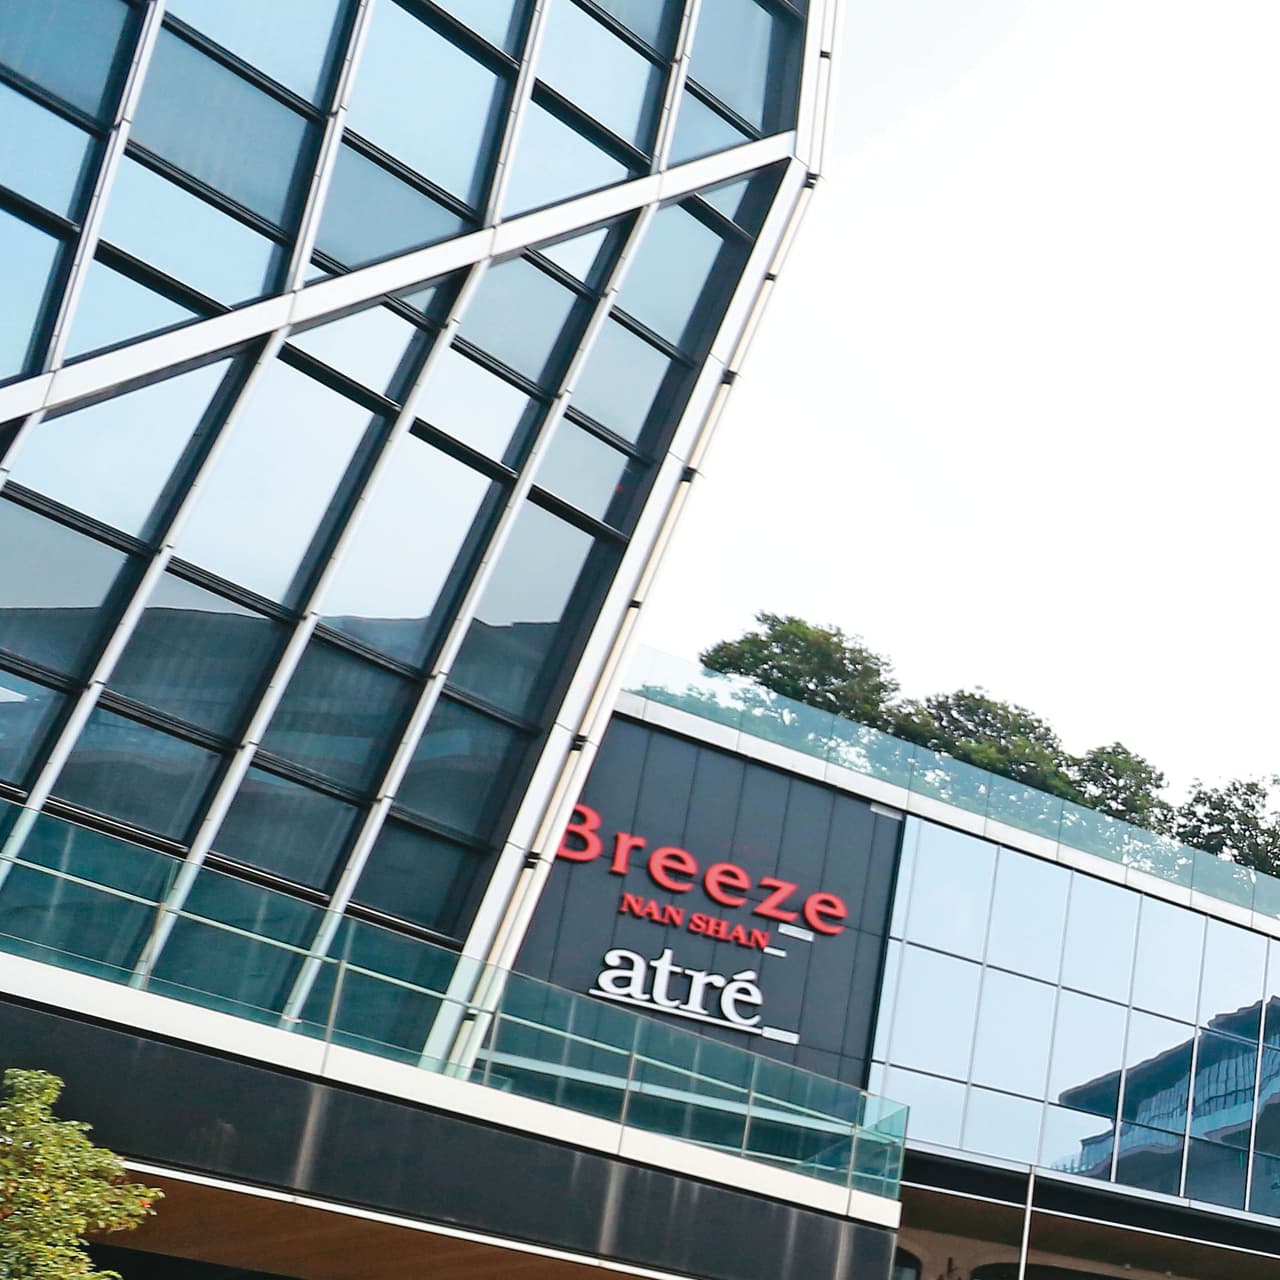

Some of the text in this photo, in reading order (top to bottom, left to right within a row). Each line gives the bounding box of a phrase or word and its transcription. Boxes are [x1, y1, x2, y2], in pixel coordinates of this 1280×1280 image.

[556, 803, 848, 935] Breeze
[620, 892, 770, 949] NAN SHAN
[597, 947, 763, 1027] atré
